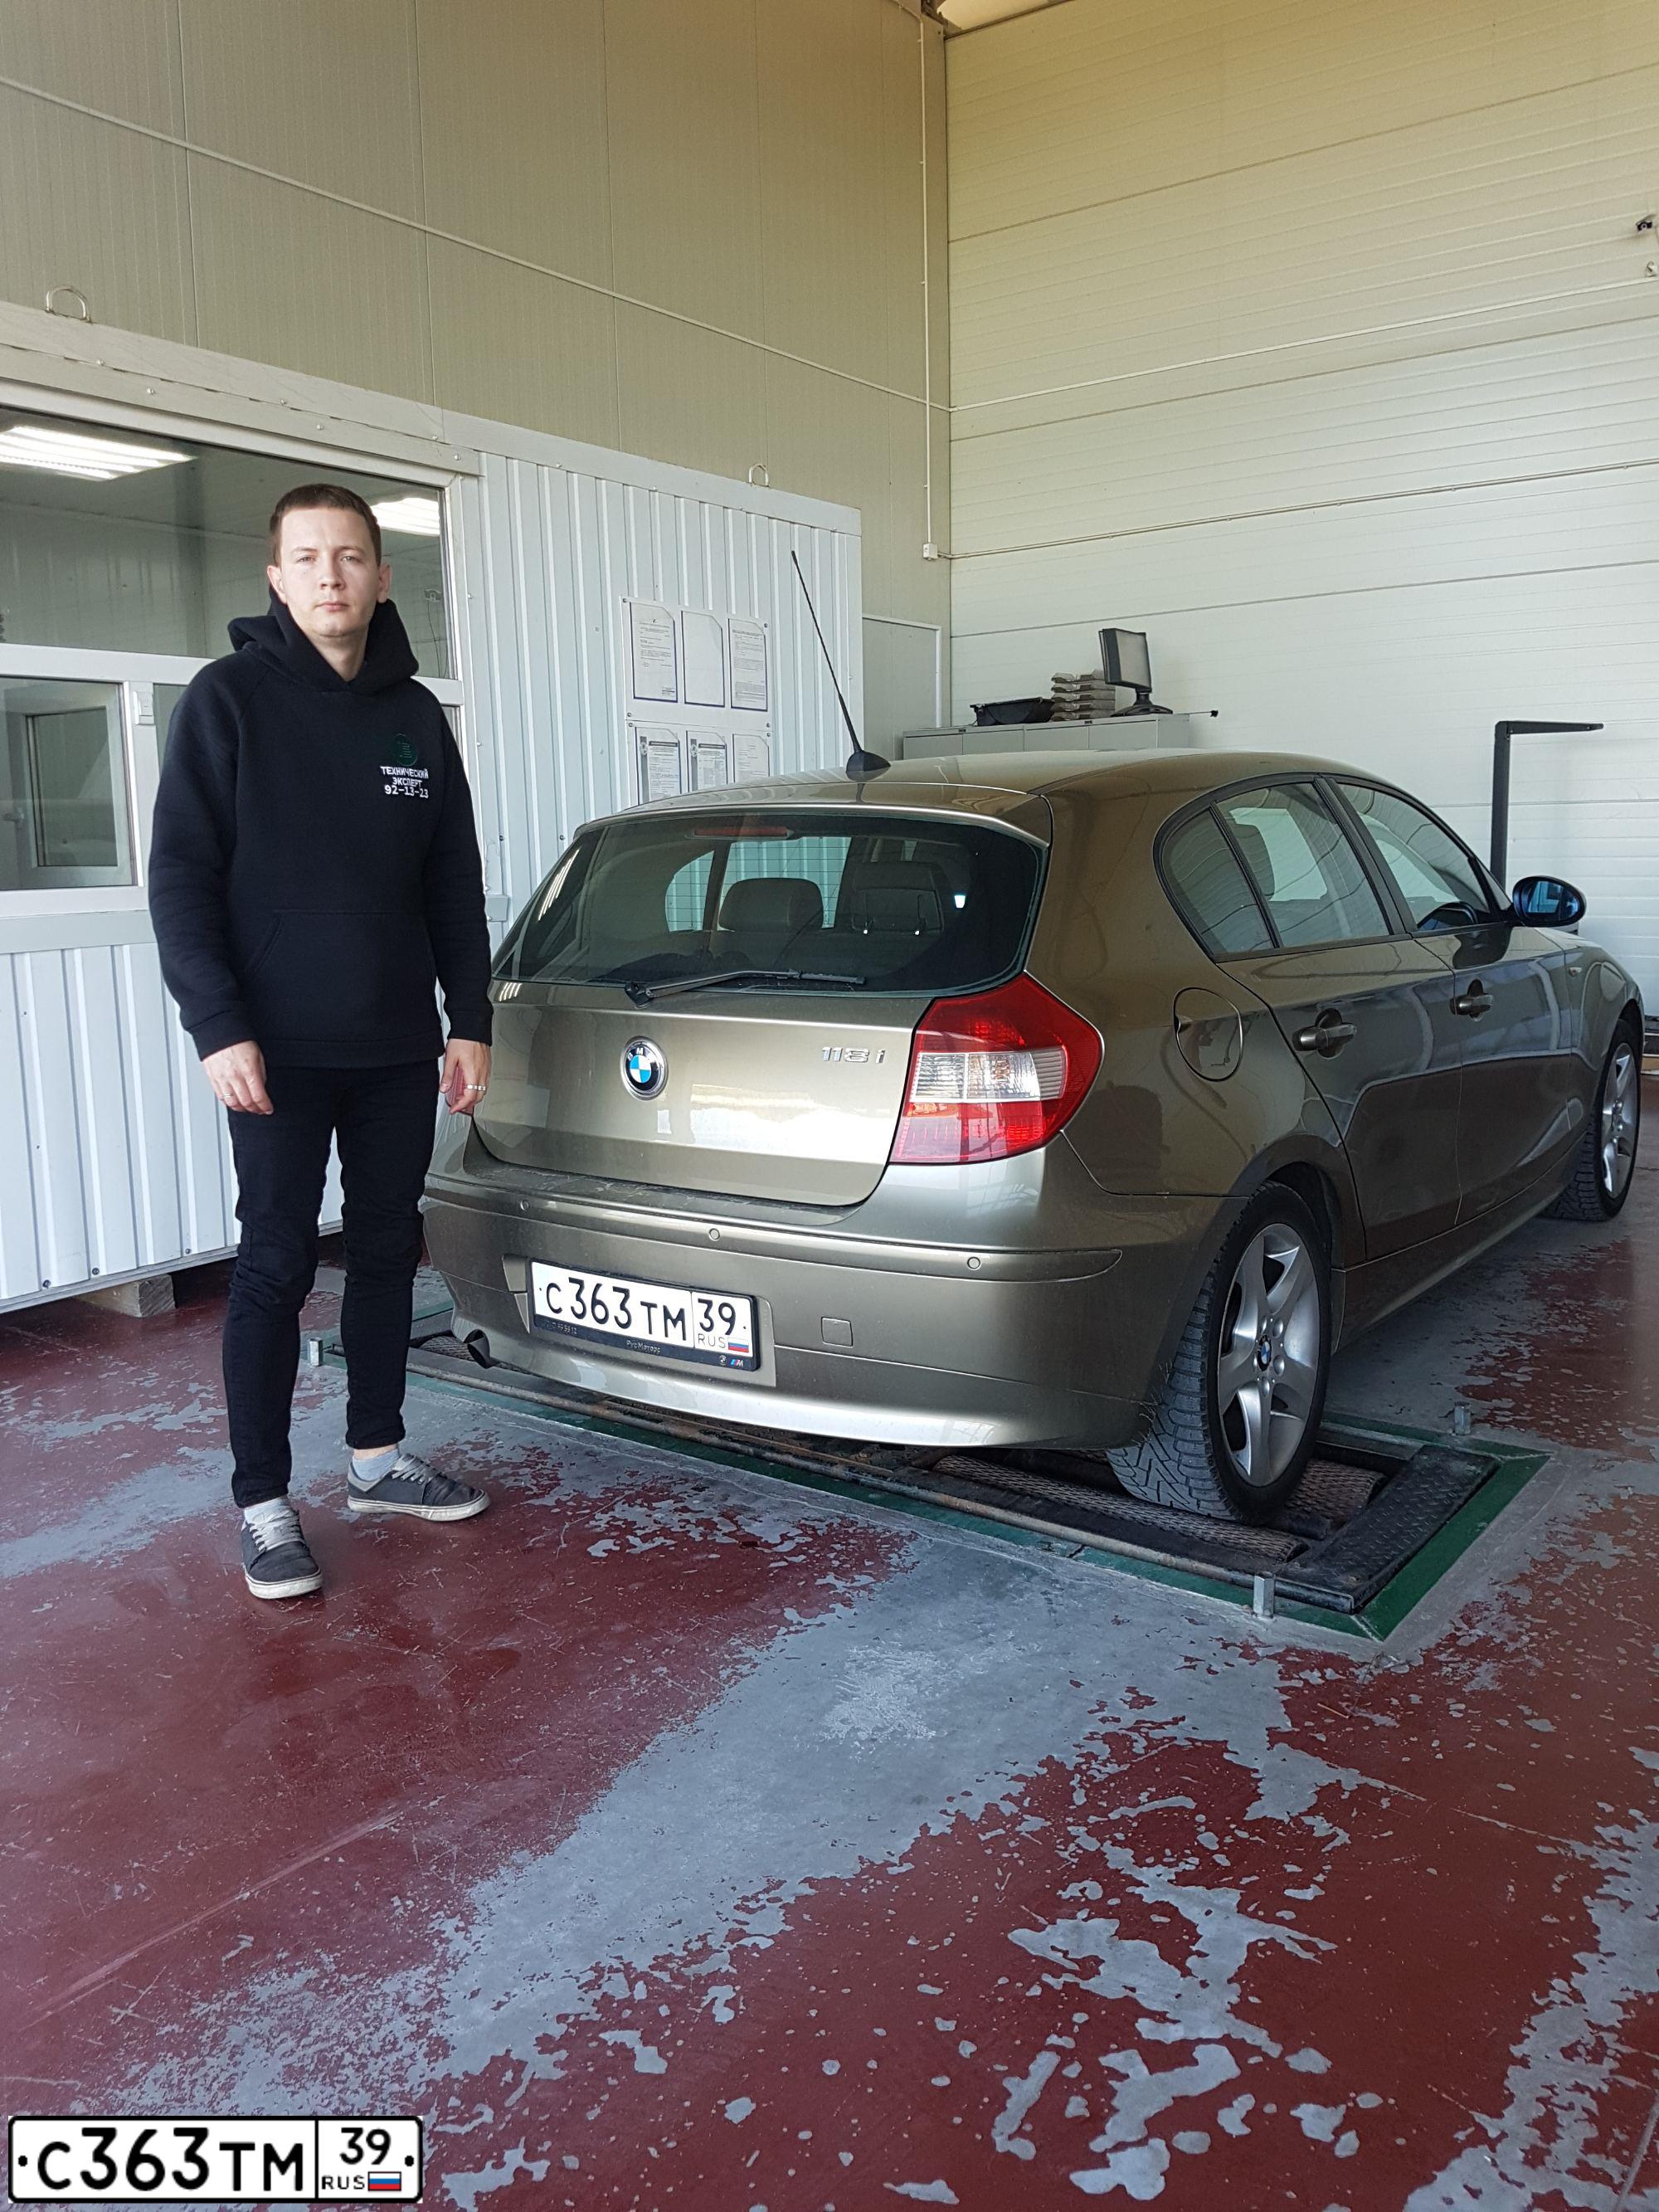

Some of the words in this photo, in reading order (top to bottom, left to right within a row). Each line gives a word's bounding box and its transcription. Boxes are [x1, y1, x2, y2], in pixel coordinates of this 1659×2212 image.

[380, 766, 429, 779] ТЕХНИЧЕСКИЙ
[392, 777, 422, 788] ЭКСПЕРТ
[384, 784, 429, 798] 92-13-23
[698, 1298, 737, 1336] 39
[698, 1333, 726, 1348] RUS
